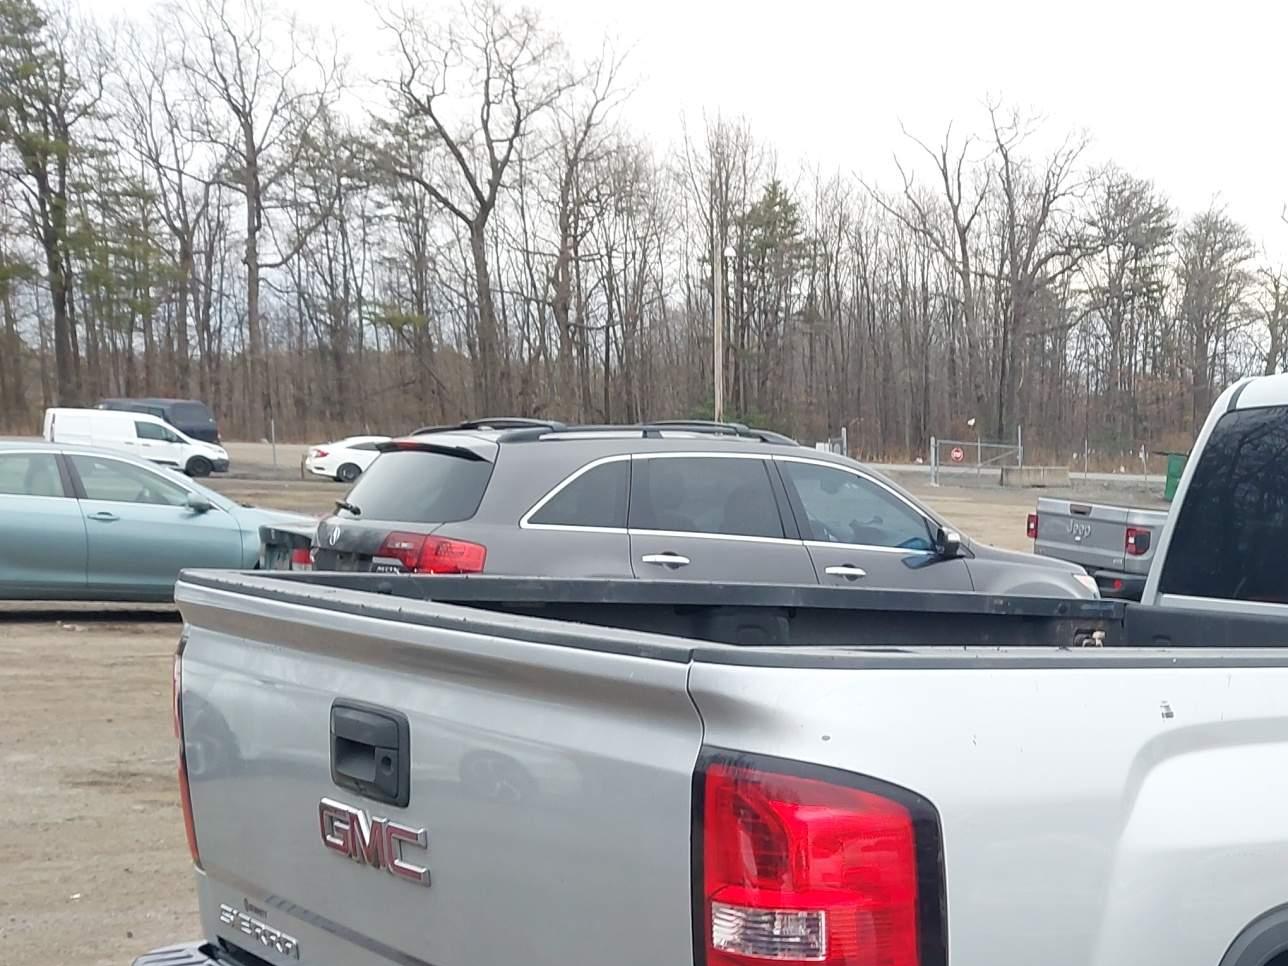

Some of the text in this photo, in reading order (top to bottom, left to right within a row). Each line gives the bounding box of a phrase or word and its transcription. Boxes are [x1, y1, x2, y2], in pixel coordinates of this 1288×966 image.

[1066, 519, 1091, 537] Jeep
[319, 797, 431, 888] GMC
[219, 903, 300, 961] SIERRA
